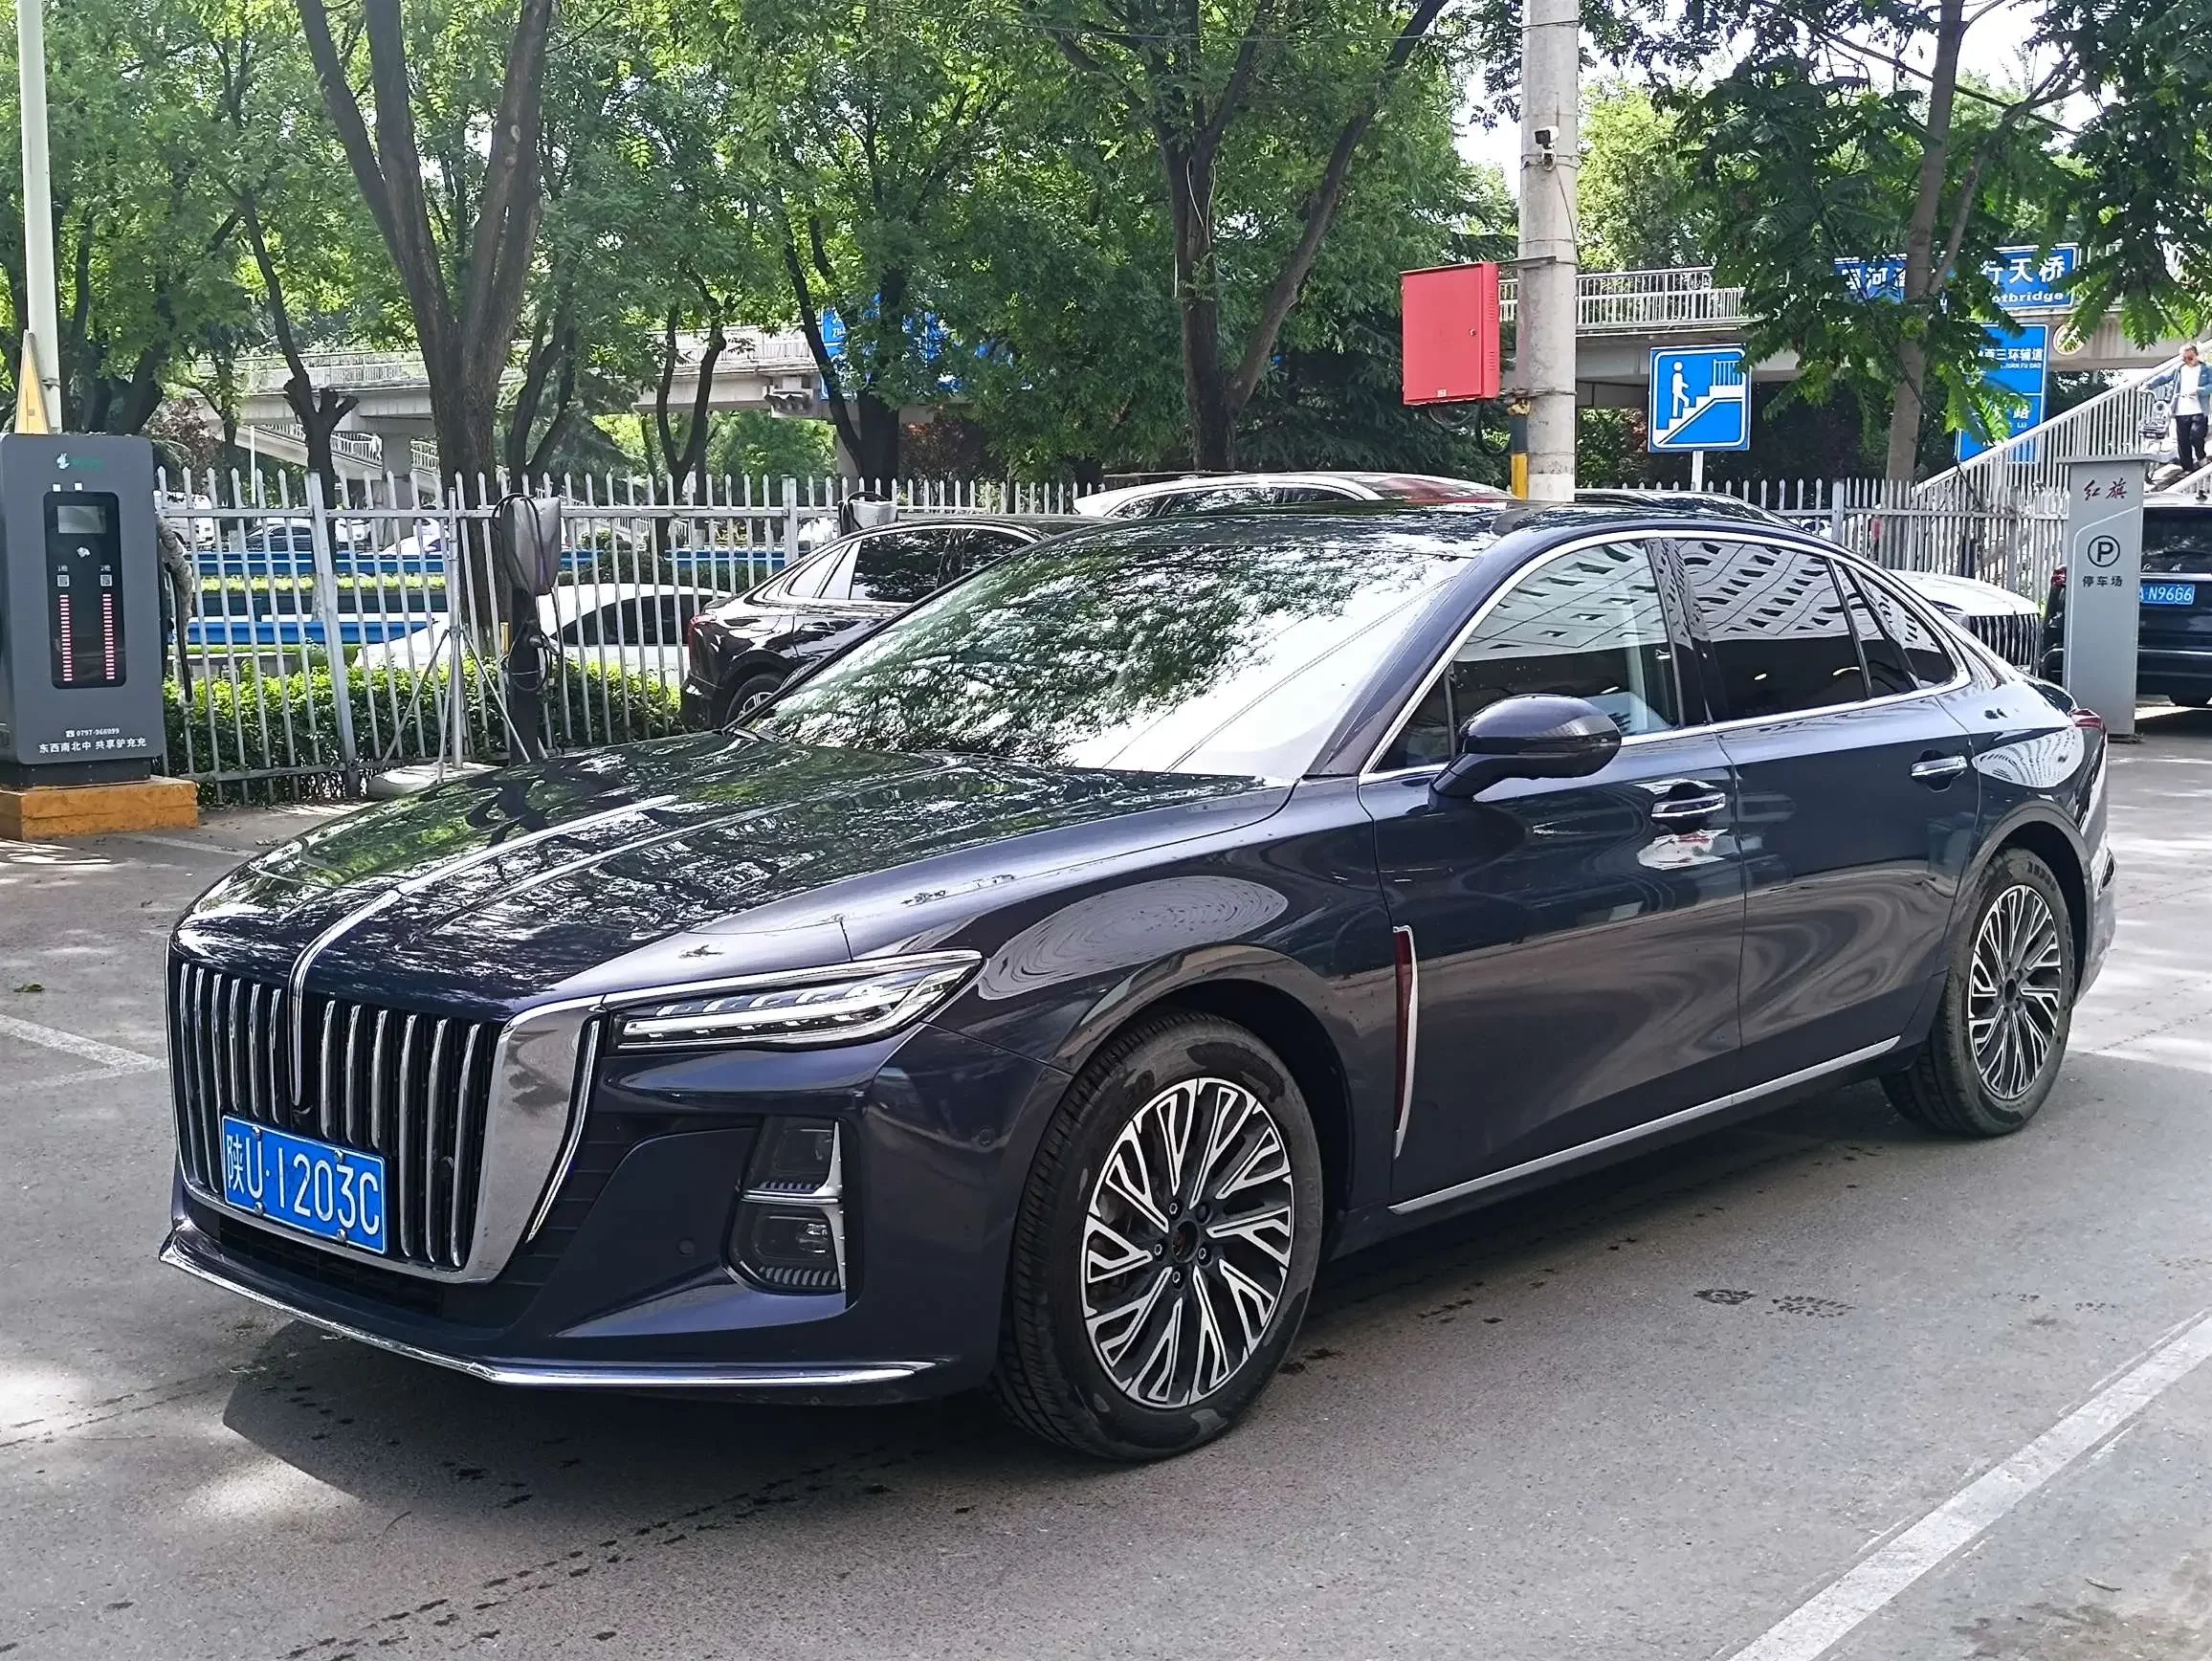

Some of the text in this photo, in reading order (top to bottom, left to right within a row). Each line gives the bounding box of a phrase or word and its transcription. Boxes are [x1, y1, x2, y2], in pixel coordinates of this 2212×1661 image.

[2084, 477, 2127, 500] 红旗
[2097, 542, 2113, 563] P
[2083, 576, 2123, 587] 停车场
[39, 741, 91, 754] 东西南北中
